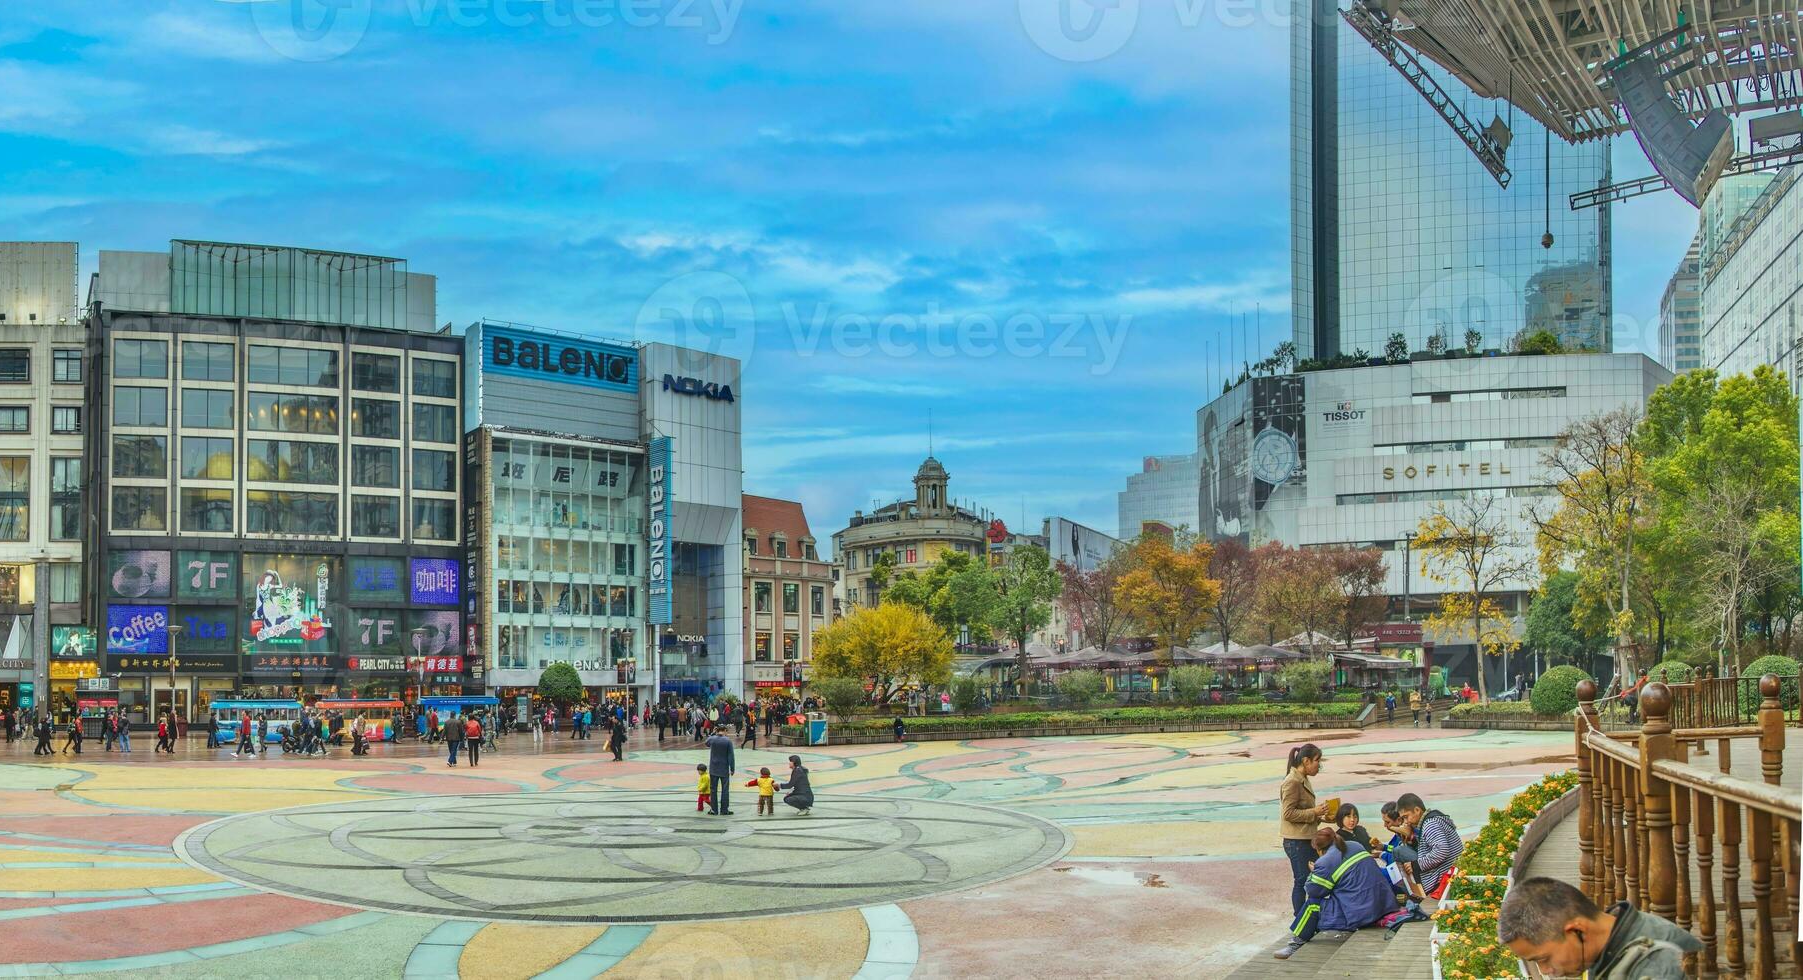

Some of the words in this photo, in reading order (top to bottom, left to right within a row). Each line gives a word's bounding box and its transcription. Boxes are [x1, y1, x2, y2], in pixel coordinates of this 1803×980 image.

[663, 373, 735, 403] NOKIA
[1323, 410, 1366, 422] TISSOT
[501, 461, 619, 488] 班尼路
[1383, 462, 1511, 480] SOFITEL
[188, 560, 230, 589] 7F
[415, 568, 457, 594] 咖啡
[108, 611, 166, 648] Coffee
[183, 615, 227, 640] Tea
[358, 617, 395, 645] 7F
[676, 634, 705, 643] NOKIA
[359, 658, 377, 670] PEARL
[378, 658, 390, 670] CITY
[426, 658, 458, 670] 肯德基
